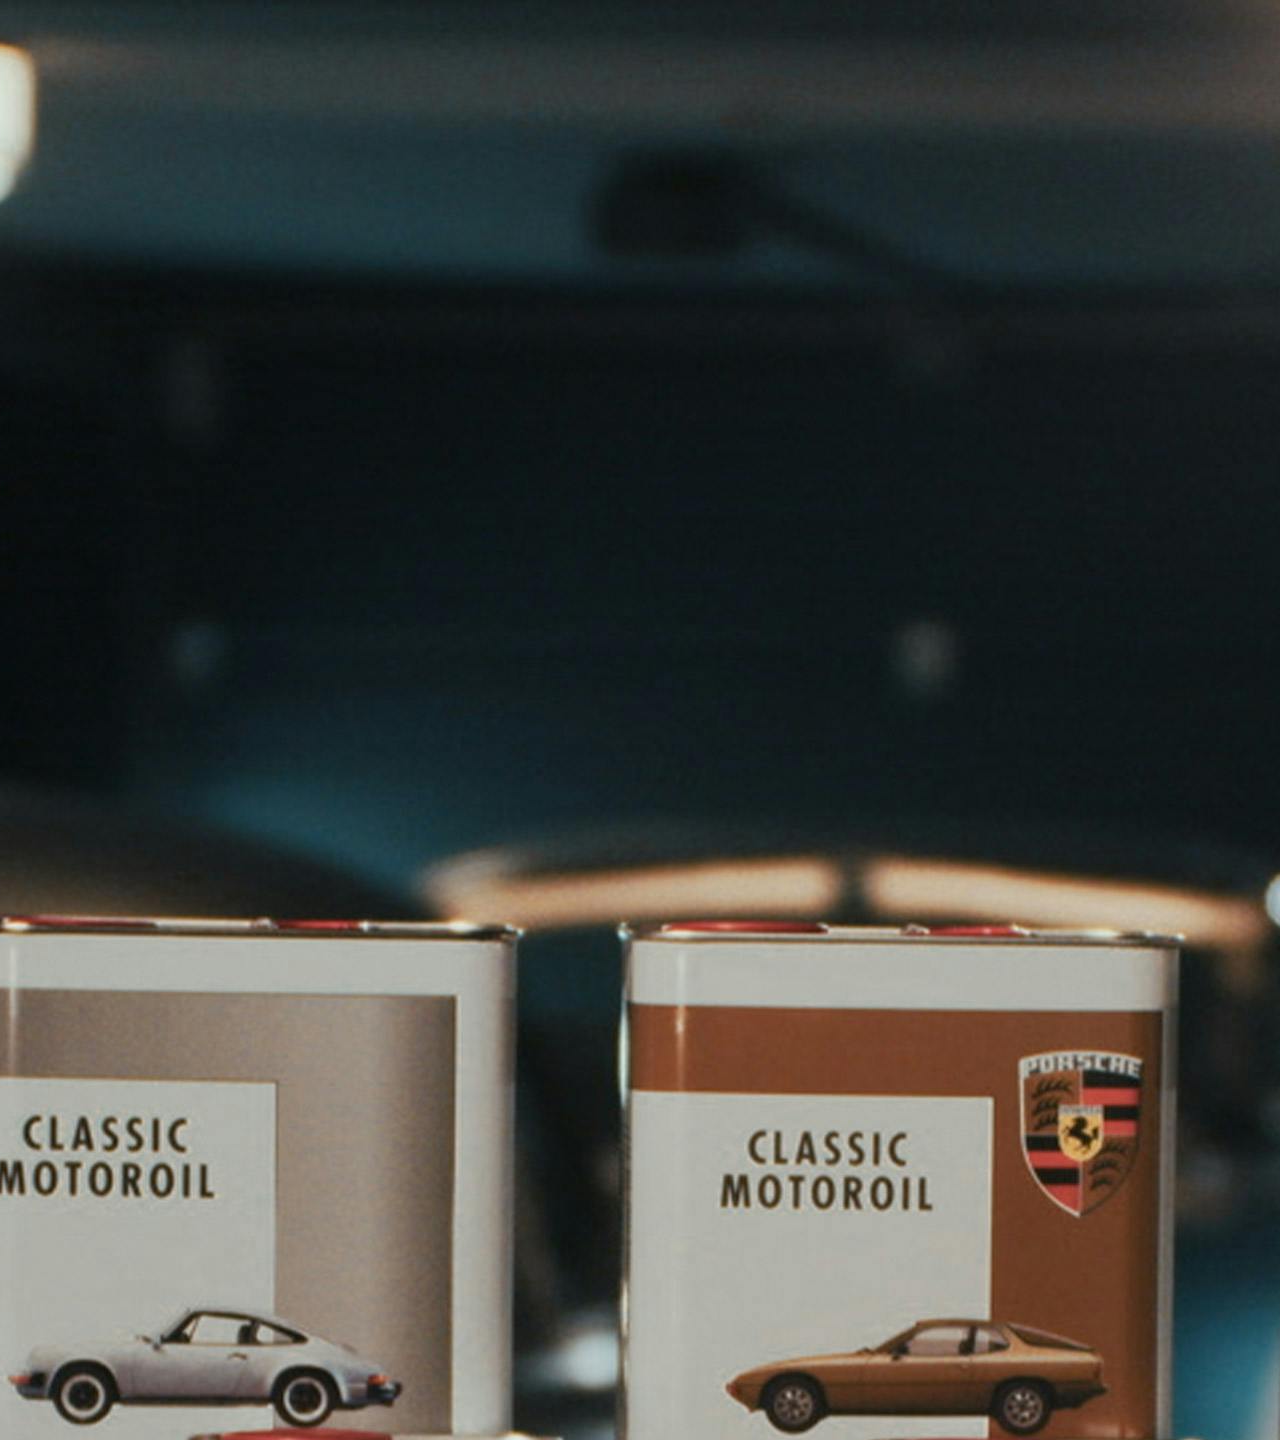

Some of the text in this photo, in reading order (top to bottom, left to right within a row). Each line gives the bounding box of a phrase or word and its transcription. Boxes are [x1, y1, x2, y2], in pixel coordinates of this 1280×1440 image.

[1020, 1051, 1141, 1080] PORSCHE
[22, 1115, 188, 1153] CLASSIC
[747, 1130, 908, 1167] CLASSIC
[720, 1174, 933, 1212] MOTOROIL
